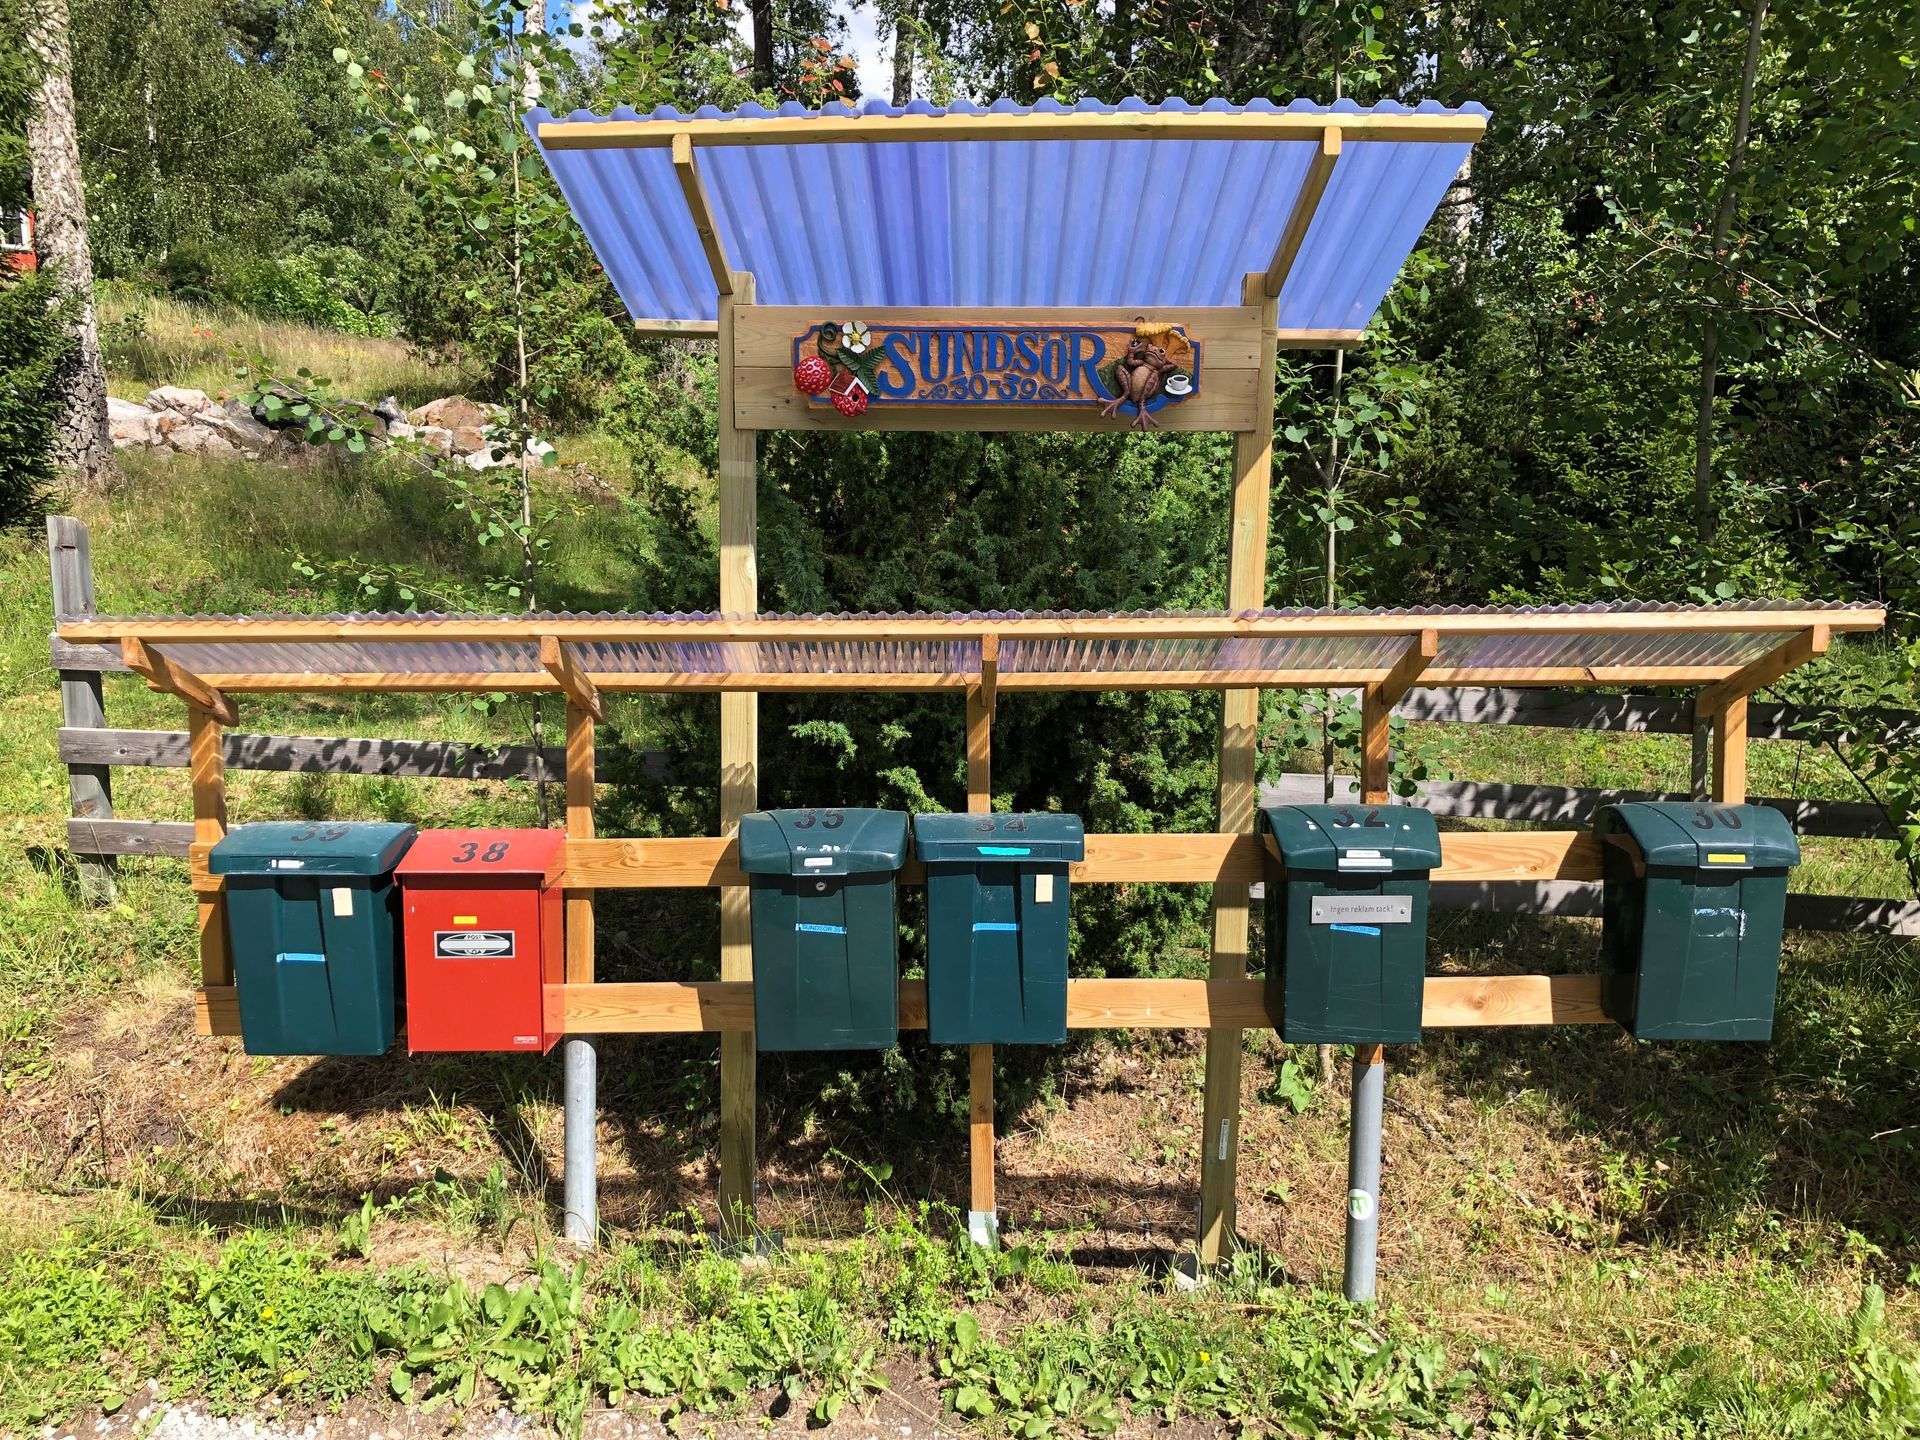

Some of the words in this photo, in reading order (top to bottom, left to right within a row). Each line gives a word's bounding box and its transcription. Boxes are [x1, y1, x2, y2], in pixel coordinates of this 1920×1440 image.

[877, 330, 1113, 399] SUNDSÖR
[951, 372, 1037, 400] 30-39
[794, 809, 845, 829] 35
[974, 814, 1028, 832] 34
[1332, 805, 1386, 828] 32
[1692, 806, 1742, 830] 30
[452, 842, 510, 863] 38
[1330, 905, 1349, 915] Ingen
[1350, 905, 1375, 913] reklam
[1376, 905, 1393, 913] tack!
